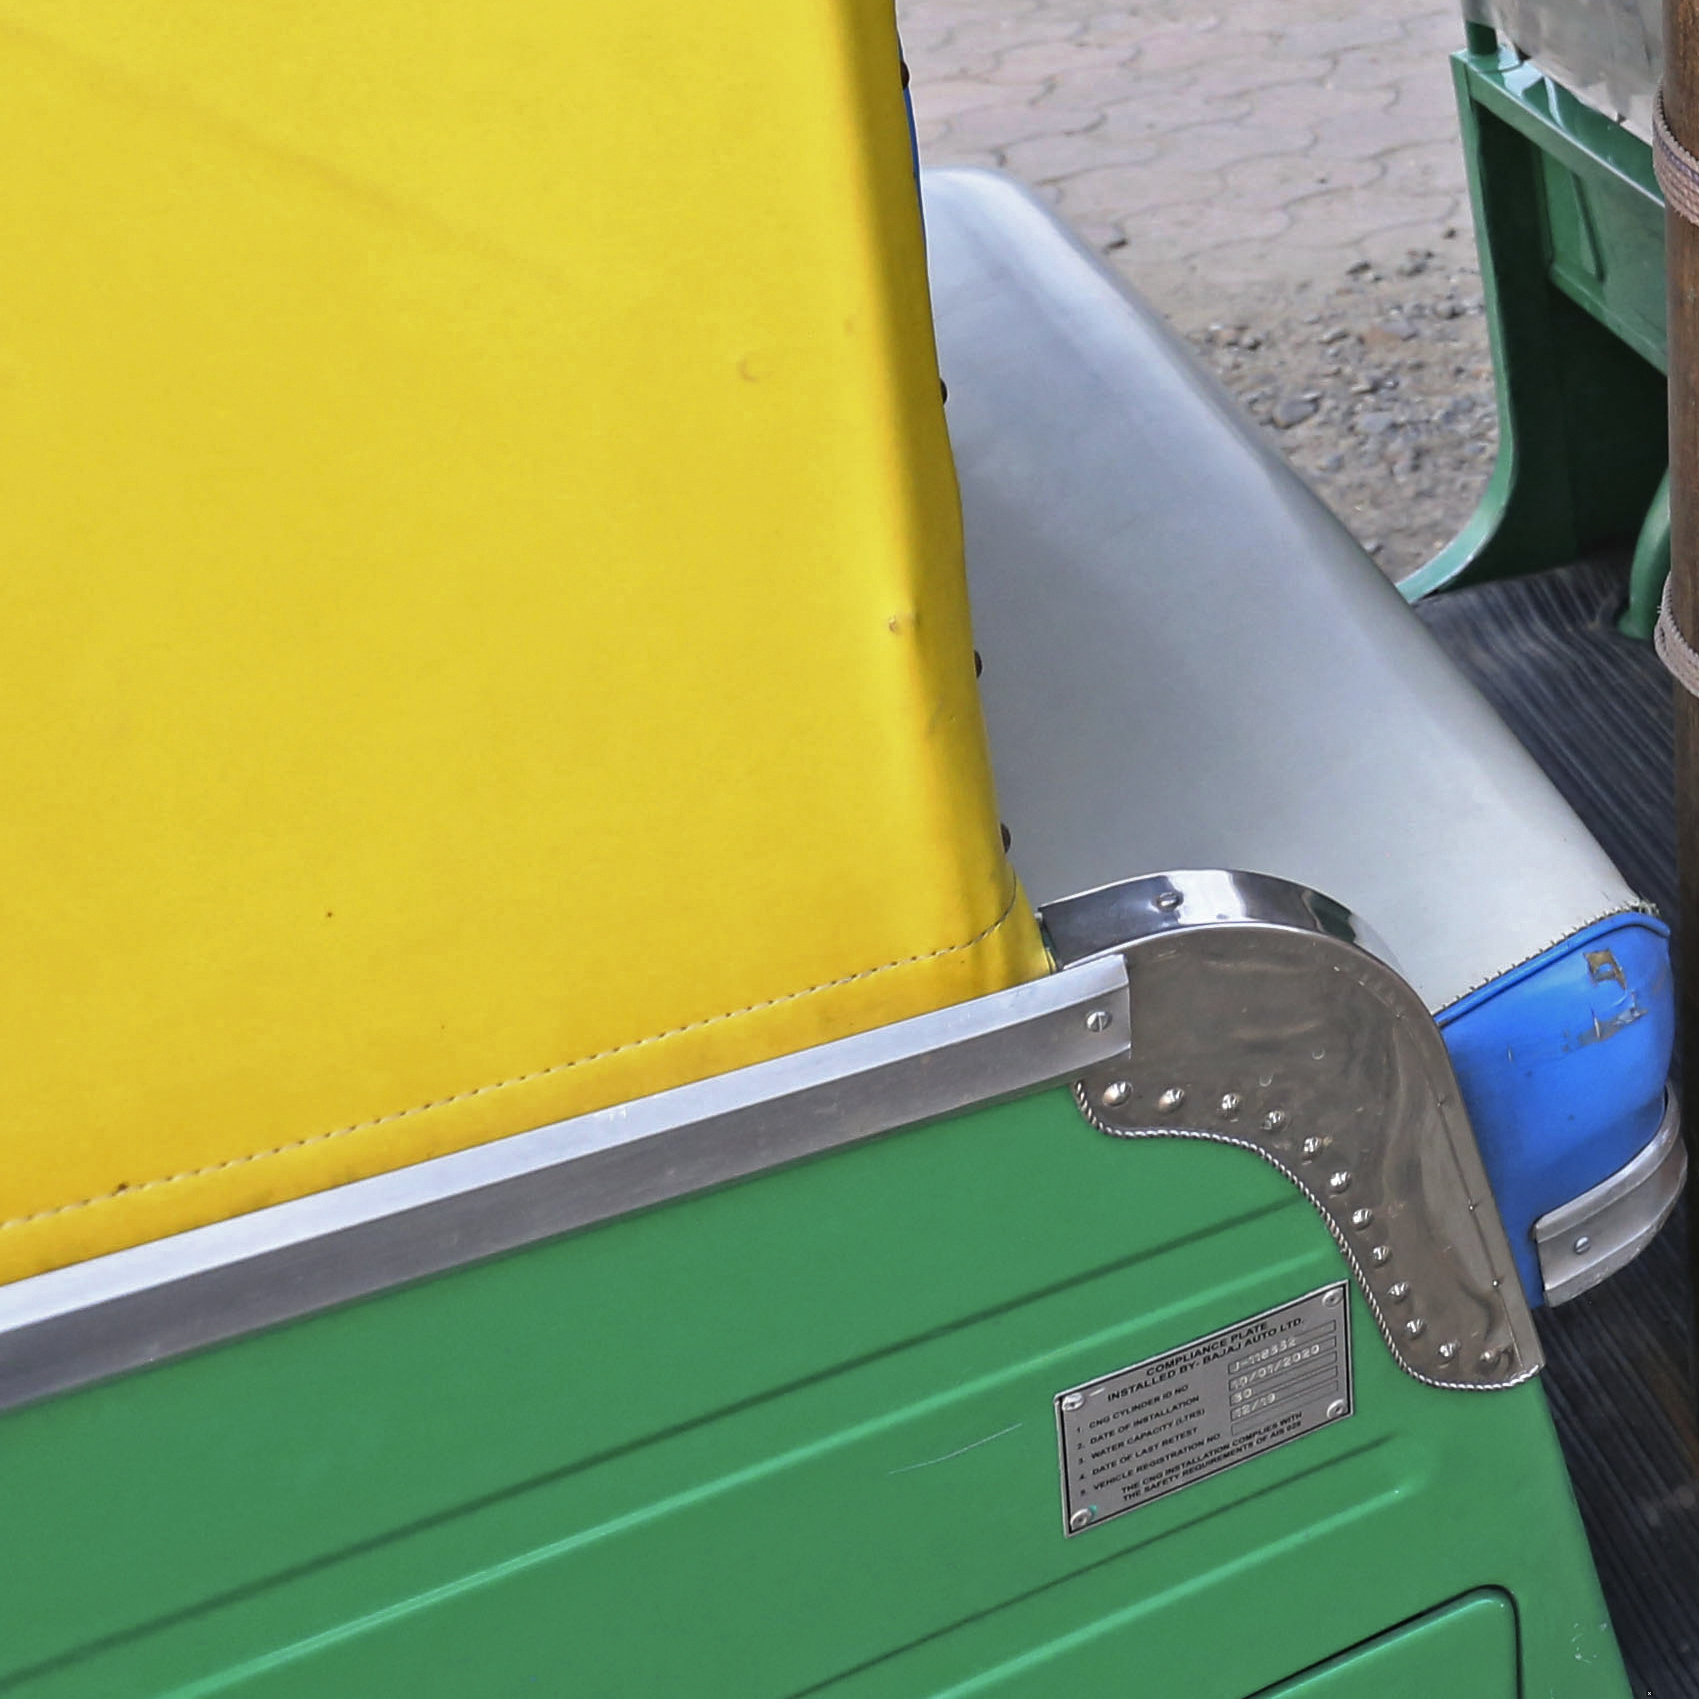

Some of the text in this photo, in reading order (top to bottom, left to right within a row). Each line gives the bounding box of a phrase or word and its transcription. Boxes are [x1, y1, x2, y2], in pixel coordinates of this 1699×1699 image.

[1108, 1370, 1176, 1402] INSTALLED
[1203, 1343, 1242, 1363] BAJAJ
[1245, 1330, 1277, 1346] AUTO
[1280, 1318, 1304, 1332] LTD.
[1146, 1324, 1266, 1376] COMPLIANCE PLATE
[1089, 1416, 1110, 1429] CNG
[1113, 1397, 1160, 1419] CYLINDER
[1174, 1384, 1188, 1394] NO
[1090, 1431, 1115, 1444] DATE
[1118, 1425, 1129, 1433] OF
[1133, 1397, 1199, 1426] INSTALLATION
[1091, 1442, 1124, 1460] WATER
[1127, 1423, 1173, 1445] CAPACITY
[1092, 1462, 1117, 1475] DATE
[1120, 1455, 1131, 1463] OF
[1135, 1445, 1159, 1457] LAST
[1161, 1429, 1198, 1446] RETEST
[1094, 1472, 1132, 1490] VEHICLE
[1136, 1441, 1204, 1472] REGISTRATION
[1206, 1434, 1220, 1443] NO
[1122, 1412, 1302, 1493] THE CNG INSTALLATION COMPLIES WITH
[1124, 1489, 1141, 1501] THE
[1144, 1474, 1179, 1492] SAFETY
[1182, 1442, 1253, 1476] REQUIREMENTS
[1256, 1436, 1266, 1444] OF
